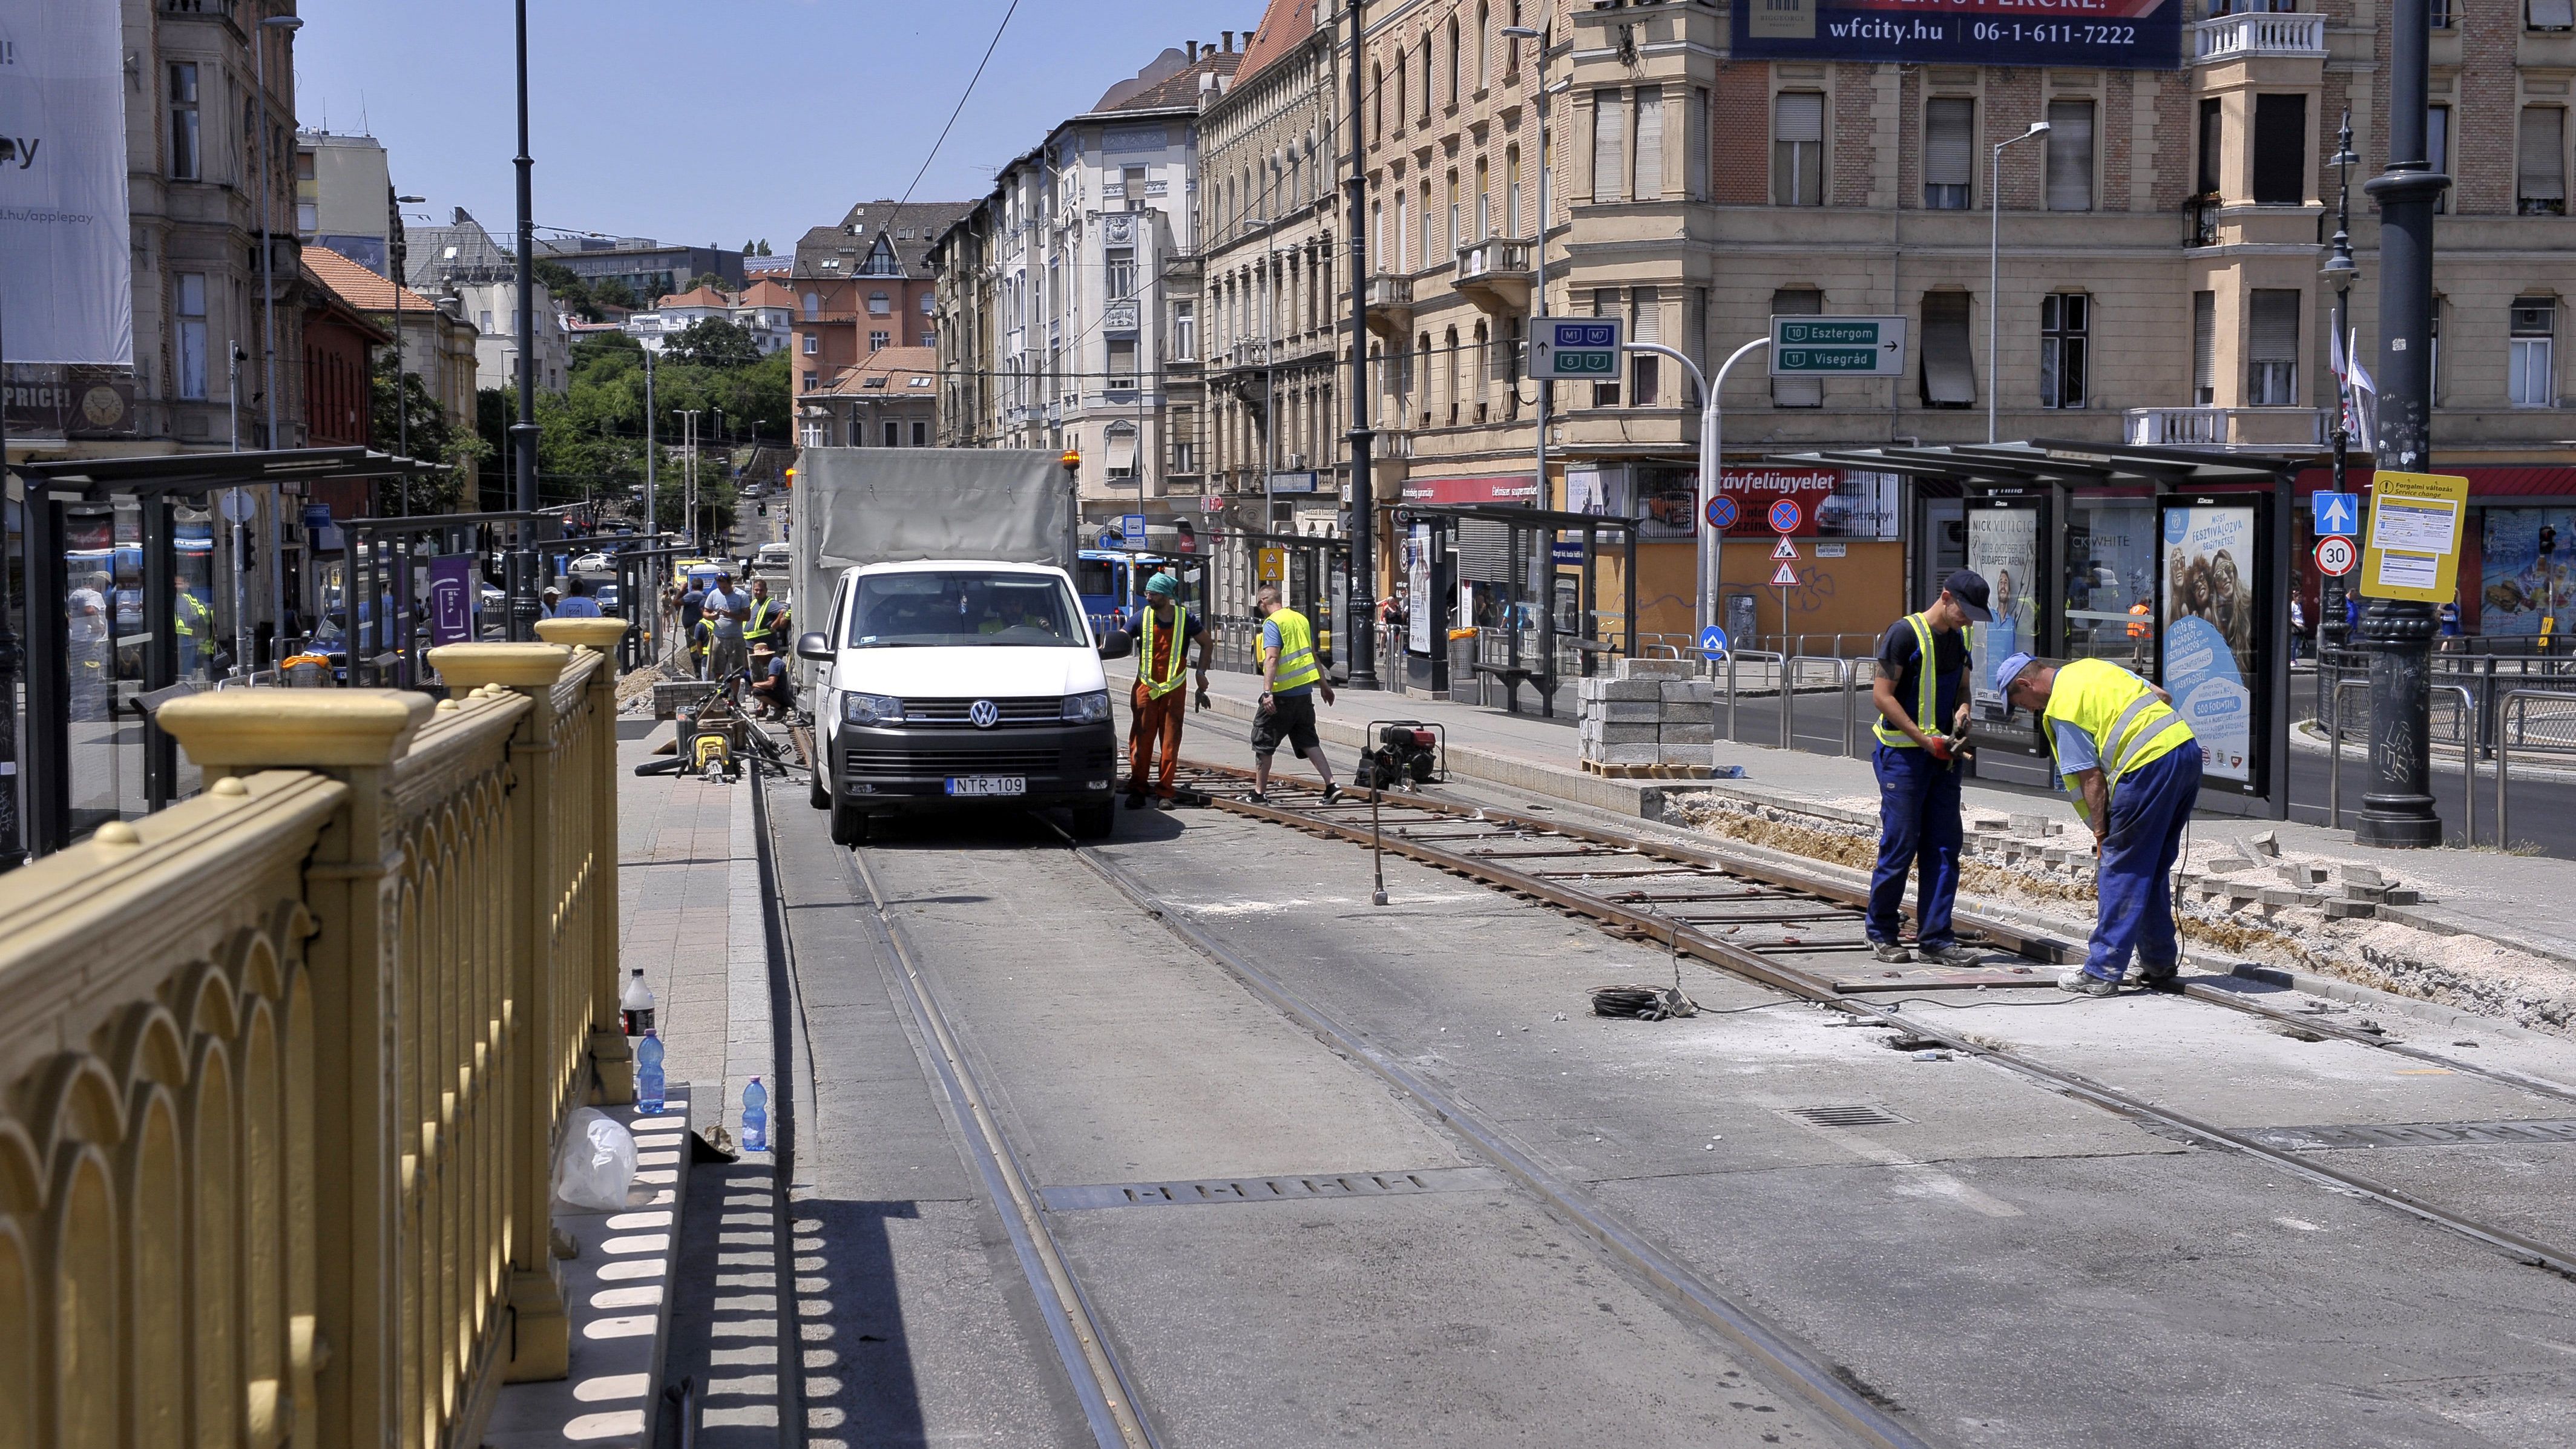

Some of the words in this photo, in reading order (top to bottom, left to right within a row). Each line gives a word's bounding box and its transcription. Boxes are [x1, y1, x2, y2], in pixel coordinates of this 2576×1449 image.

[1830, 18, 1942, 44] wfcity.hu
[1974, 22, 2135, 44] 06-1-611-7222
[0, 209, 94, 225] .hu/applepay
[1566, 331, 1577, 340] M1
[1592, 331, 1604, 340] M7
[1792, 329, 1801, 337] 10
[1812, 327, 1873, 340] Esztergom
[1567, 357, 1574, 366] 6
[1594, 357, 1600, 366] 7
[1815, 352, 1867, 366] Visegrád
[3, 387, 71, 407] PRICE!
[2396, 482, 2425, 490] Forgalmi
[2211, 513, 2226, 525] MOST
[1973, 520, 1991, 531] NICK
[1994, 520, 2034, 534] VUJICIC
[2192, 520, 2243, 544] FESZTIVÁLOZVA
[2072, 536, 2088, 548] CK
[2091, 535, 2131, 547] WHITE
[1981, 554, 2008, 565] BUDAPEST
[2008, 554, 2025, 566] ARÉNA
[2326, 548, 2345, 563] 30
[2187, 620, 2196, 630] FEL
[2197, 703, 2208, 714] 500
[957, 778, 1022, 793] NTR-109
